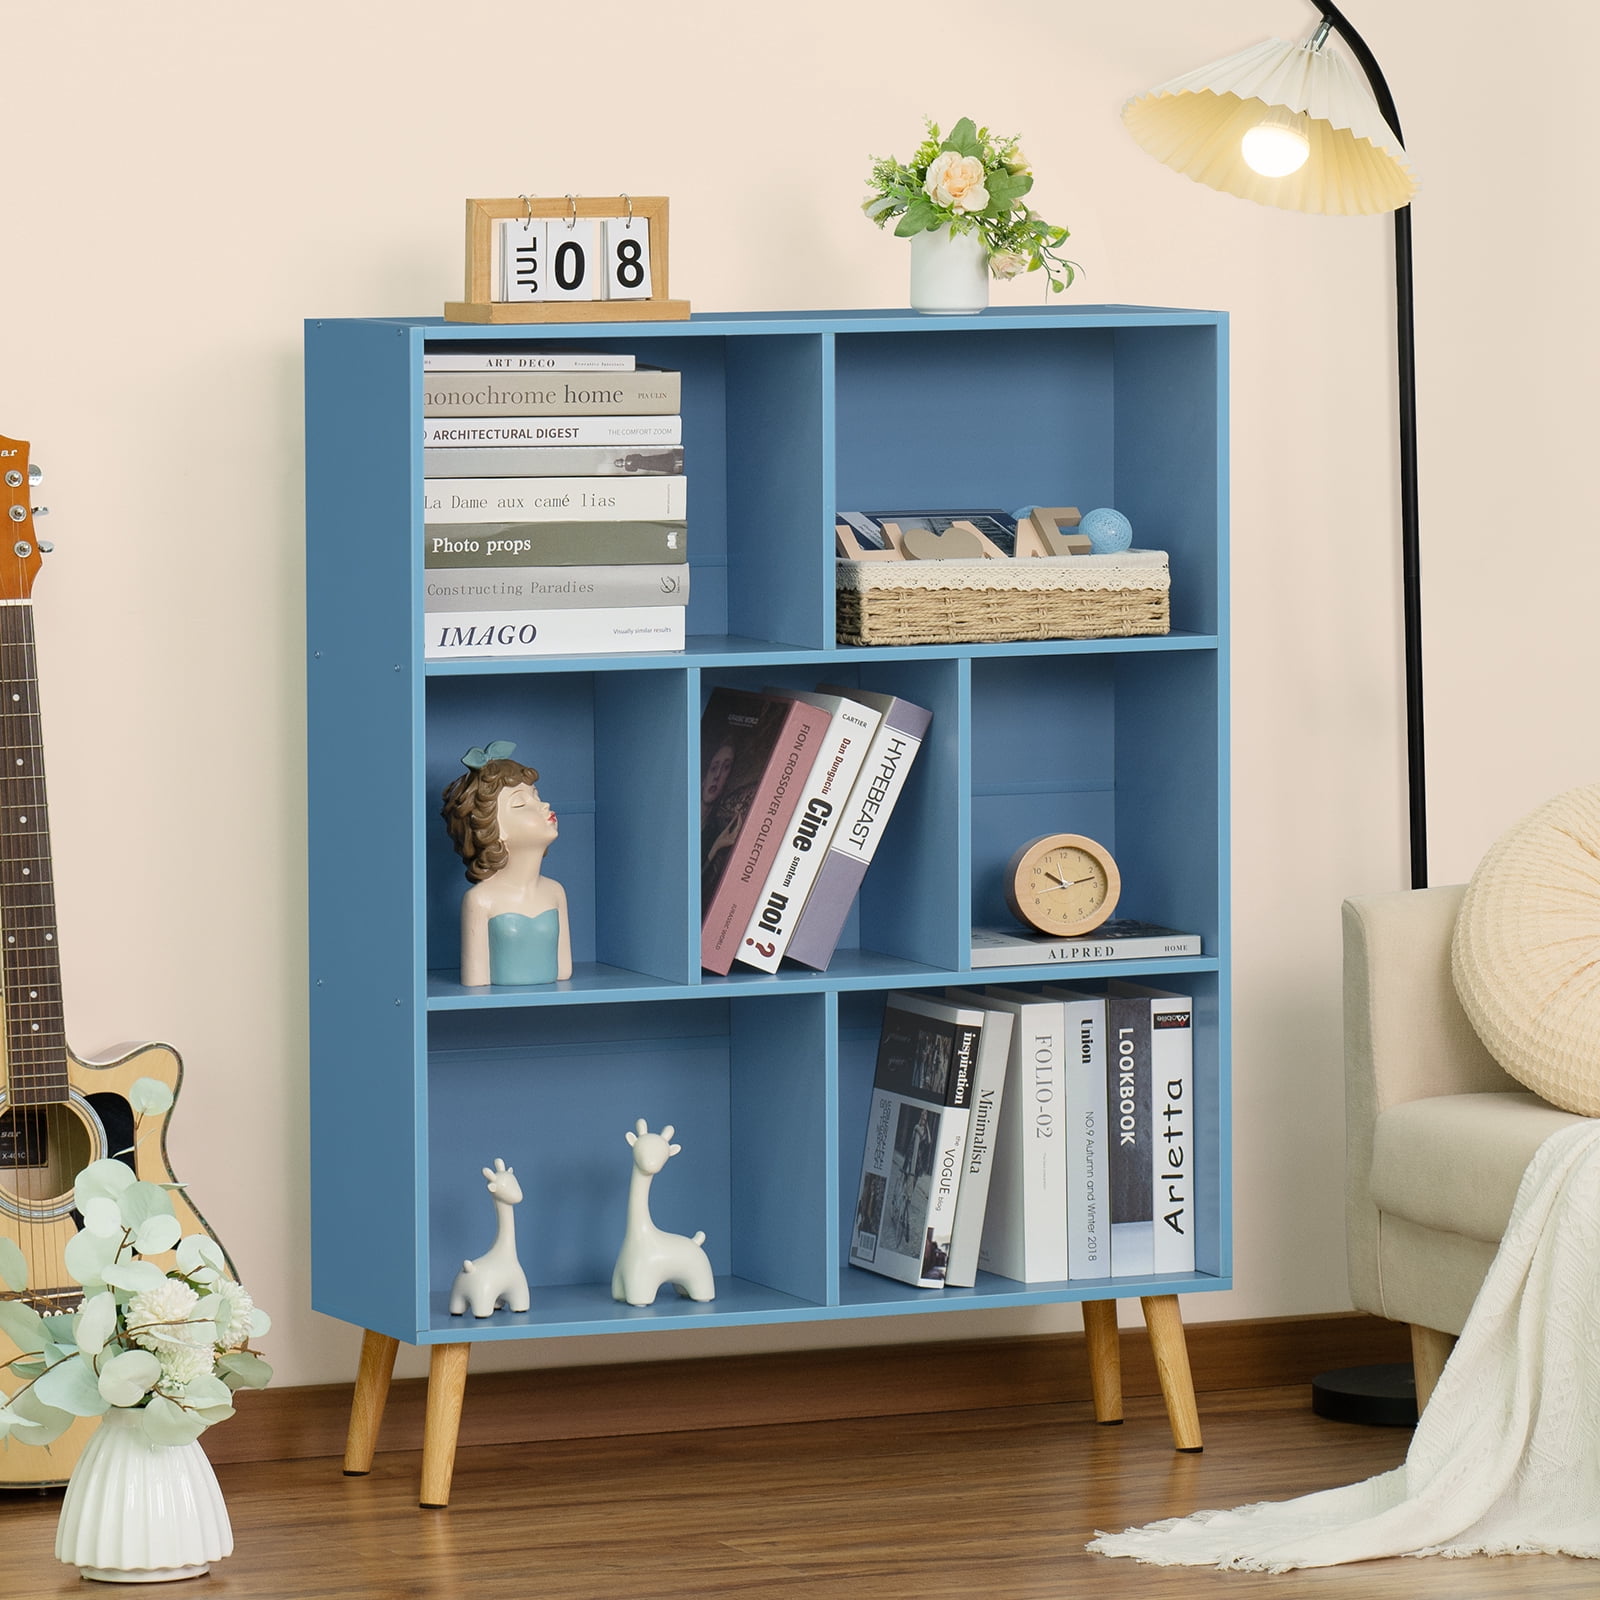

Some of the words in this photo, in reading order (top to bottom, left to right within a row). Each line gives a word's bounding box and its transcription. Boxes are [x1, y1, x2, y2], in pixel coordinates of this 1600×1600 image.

[516, 236, 538, 293] JUL
[554, 241, 585, 291] 0
[616, 239, 645, 288] 8
[486, 358, 513, 368] ART
[518, 358, 556, 368] DECO
[563, 384, 624, 404] home
[432, 428, 533, 441] ARCHITECTURAL
[536, 427, 580, 439] DIGEST
[608, 428, 621, 436] THE
[621, 428, 653, 436] COMFORT
[653, 427, 672, 435] ZOOM
[424, 495, 442, 510] La
[451, 495, 488, 509] Dame
[497, 498, 525, 509] aux
[534, 495, 570, 508] camé
[581, 493, 616, 508] lias
[432, 536, 480, 553] Photo
[486, 537, 532, 556] props
[427, 583, 523, 597] Constructing
[530, 581, 595, 595] Paradies
[437, 624, 538, 648] IMAGO
[612, 627, 634, 636] Visually
[634, 626, 653, 635] similar
[653, 626, 673, 634] results
[841, 713, 869, 729] CARTIER
[796, 723, 811, 752] FION
[836, 737, 852, 756] Dan
[767, 752, 800, 816] CROSSOVER
[821, 755, 845, 795] Dungaciu
[848, 737, 906, 851] HYPEBEAST
[792, 796, 834, 853] Cine
[741, 817, 773, 884] COLLECTION
[758, 891, 790, 936] noi
[745, 937, 776, 958] ?
[1048, 946, 1115, 960] ALPRED
[1164, 944, 1188, 952] HOME
[1080, 1018, 1094, 1065] Union
[954, 1031, 977, 1105] inspiration
[1034, 1034, 1054, 1139] FOLIO-02
[1118, 1028, 1137, 1147] LOOKBOOK
[970, 1089, 995, 1174] Minimalista
[939, 1148, 956, 1195] VOGUE
[1085, 1138, 1095, 1178] Autumn
[1161, 1078, 1186, 1236] Arletta
[1086, 1180, 1096, 1201] and
[1087, 1202, 1096, 1234] Winter
[1087, 1236, 1097, 1262] 2018
